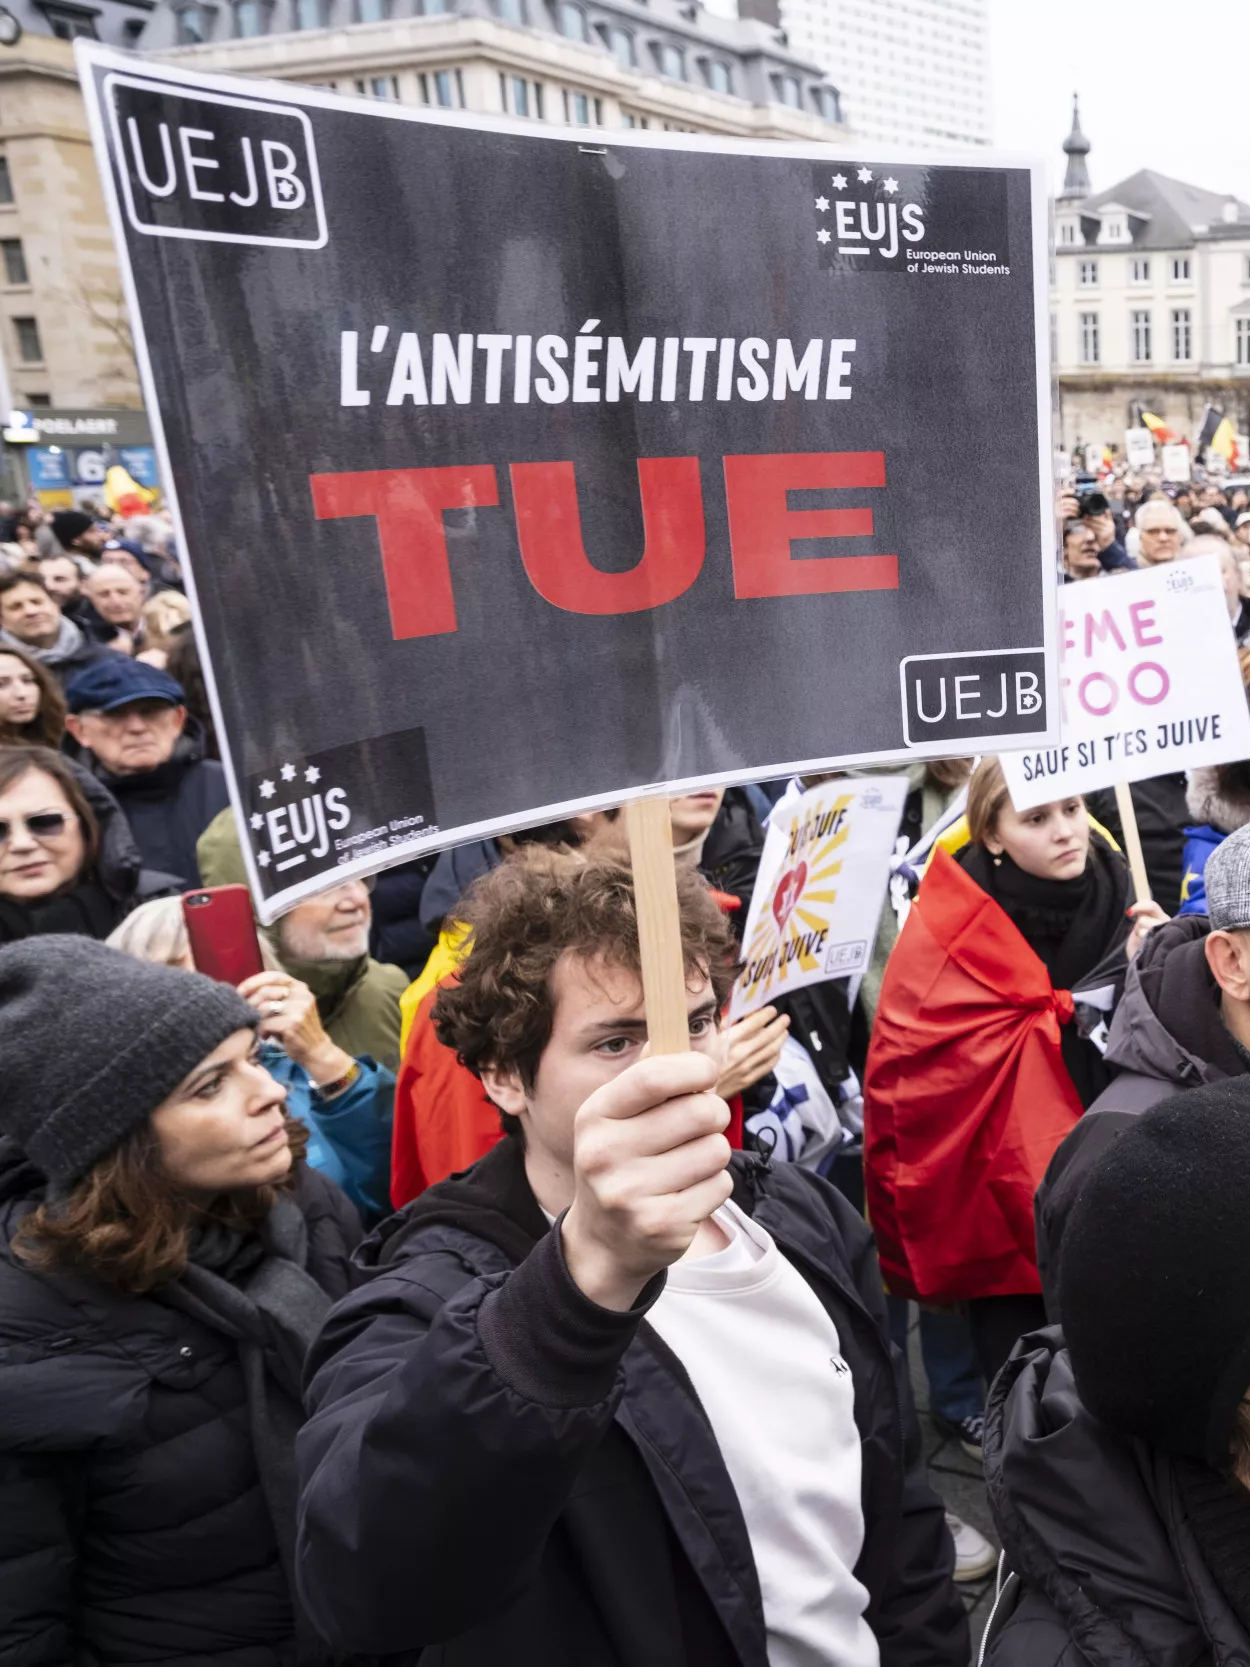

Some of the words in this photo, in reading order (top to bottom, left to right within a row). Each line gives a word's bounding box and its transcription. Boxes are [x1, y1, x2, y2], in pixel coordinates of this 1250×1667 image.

[127, 117, 306, 210] UEJB
[835, 200, 926, 258] EUJS
[906, 249, 961, 263] European
[964, 250, 996, 262] Union
[907, 263, 919, 273] of
[921, 263, 958, 274] Jewish
[962, 263, 1010, 275] Students
[340, 319, 857, 406] L'ANTISÉMITISME
[309, 451, 899, 641] TUE
[915, 671, 1042, 723] UEJB
[1023, 747, 1070, 781] SAUF
[1078, 740, 1096, 767] SI
[1104, 729, 1148, 761] T'ES
[1156, 714, 1222, 749] JUIVE
[266, 787, 351, 858] EUJS
[334, 826, 389, 852] European
[388, 815, 424, 831] Union
[389, 825, 439, 847] Students
[809, 808, 847, 841] JUIF
[779, 928, 829, 968] JUIVE
